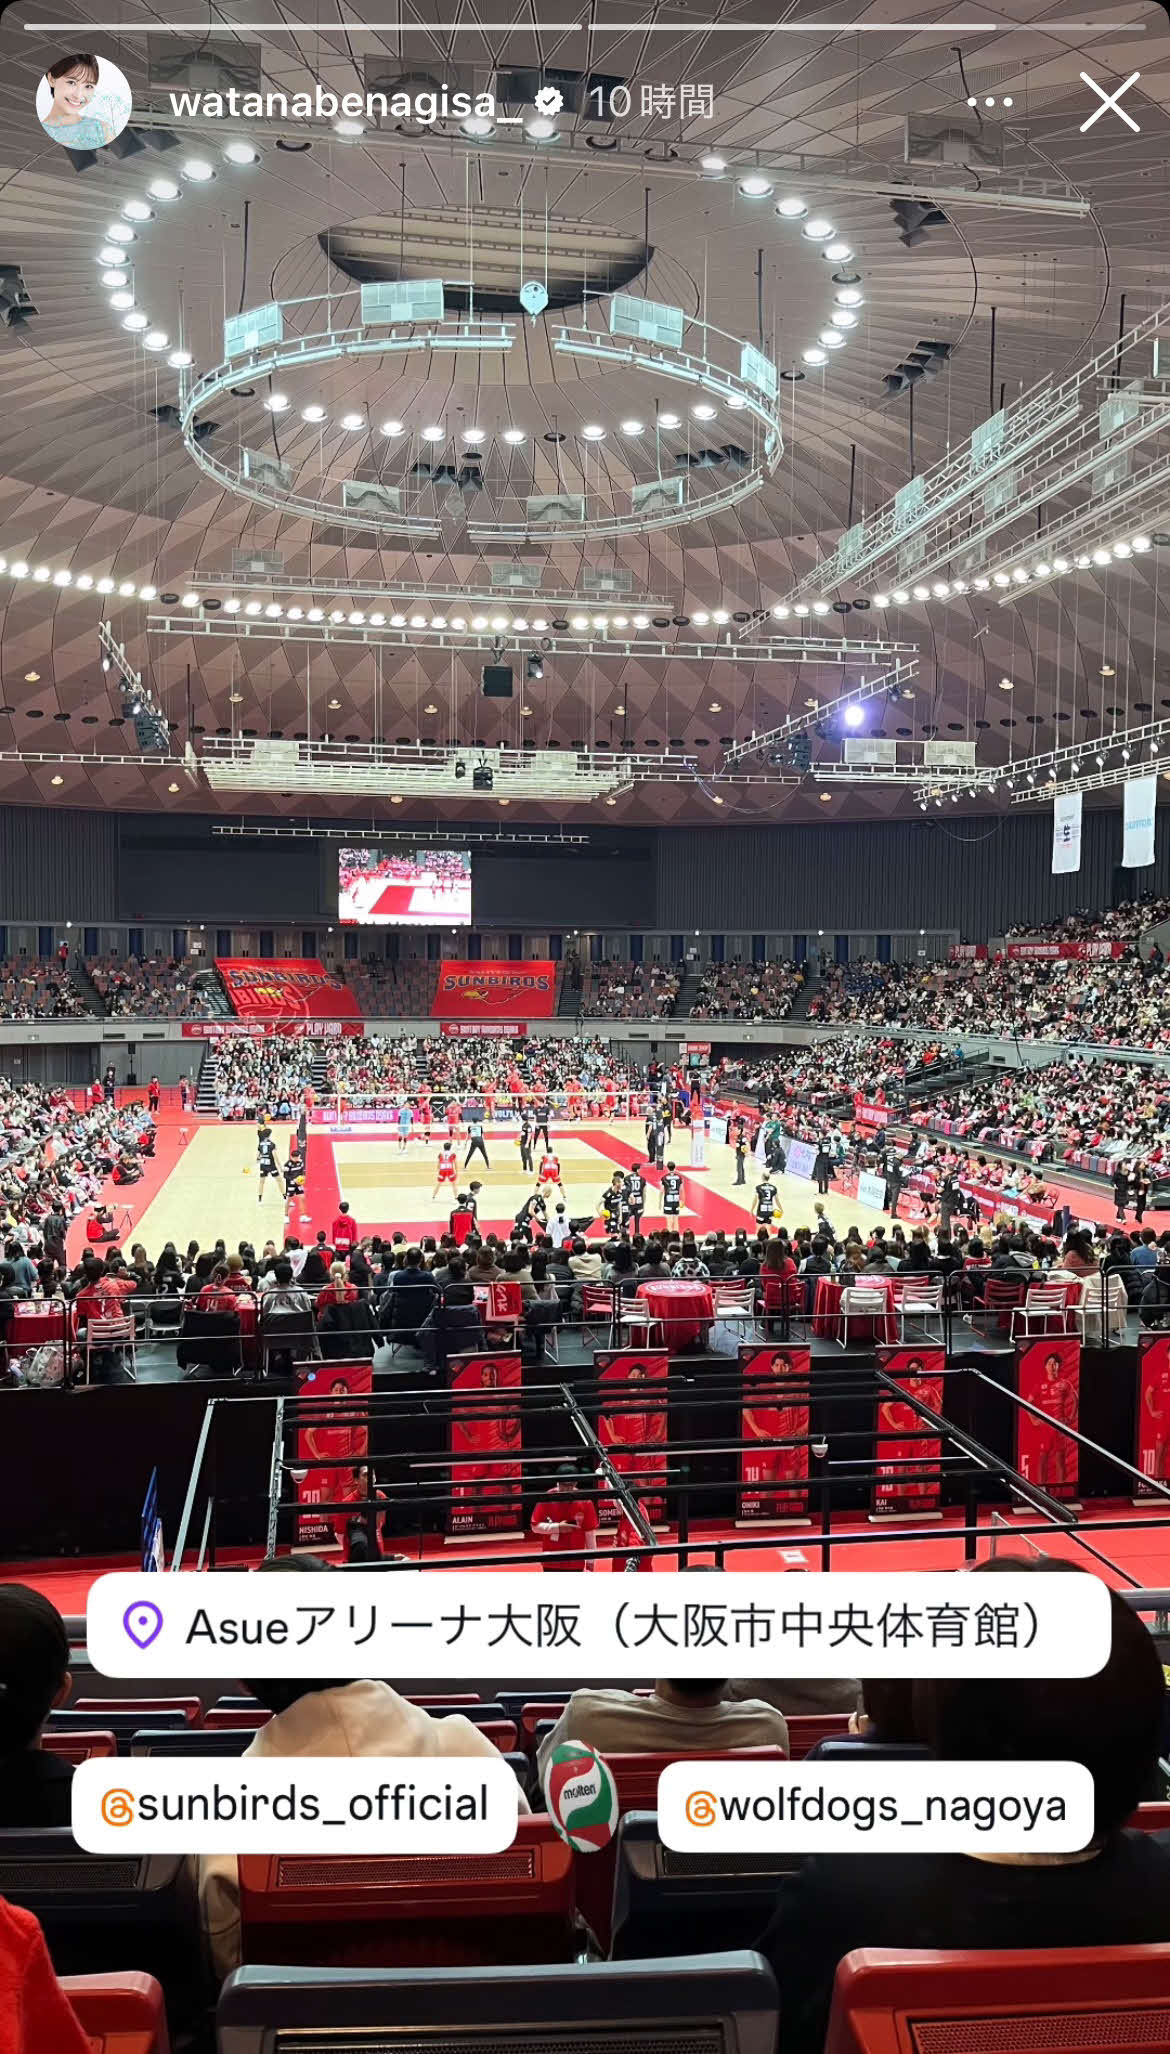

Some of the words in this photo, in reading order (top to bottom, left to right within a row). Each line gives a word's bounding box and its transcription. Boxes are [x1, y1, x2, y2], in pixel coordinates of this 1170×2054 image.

[229, 969, 343, 991] SUNBIRDS
[442, 974, 550, 992] SUNBIRDS
[670, 1179, 677, 1190] 9
[764, 1190, 771, 1200] 3
[1143, 1449, 1156, 1475] 10
[453, 1516, 473, 1524] ALAIN
[299, 1525, 328, 1534] NISHIDA
[563, 1784, 597, 1800] molten
